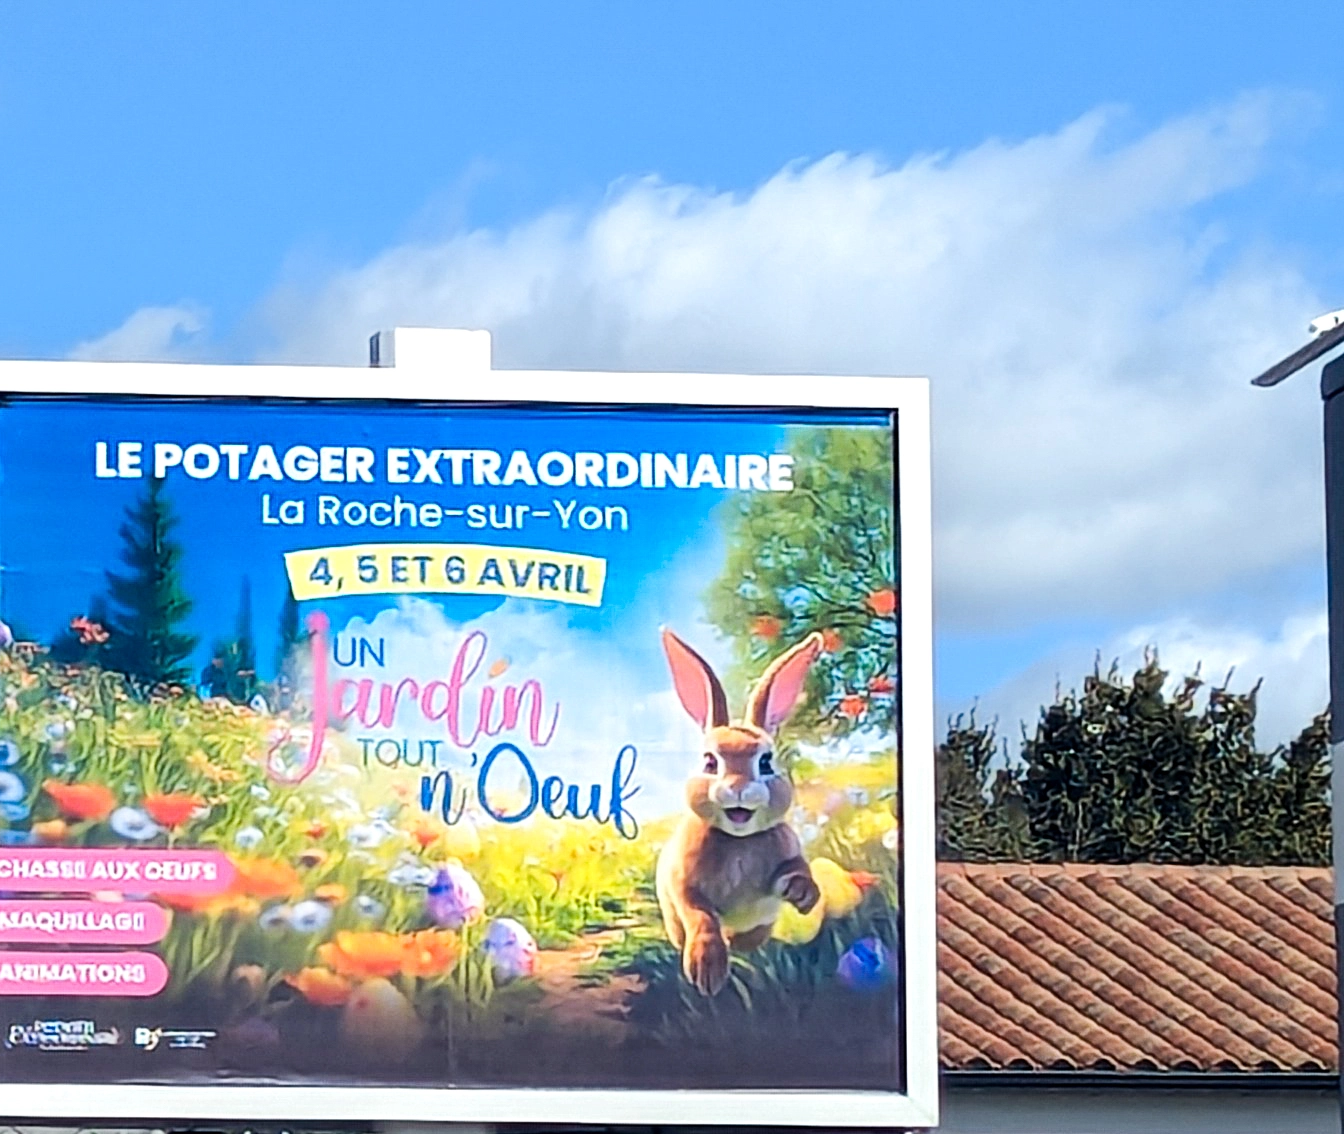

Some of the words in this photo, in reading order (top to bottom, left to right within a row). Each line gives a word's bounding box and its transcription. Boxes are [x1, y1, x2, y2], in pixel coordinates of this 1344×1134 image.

[95, 441, 143, 478] LE
[154, 443, 375, 482] POTAGER
[386, 448, 795, 491] EXTRAORDINAIRE
[261, 493, 305, 524] La
[318, 494, 629, 531] Roche-sur-Yon
[309, 556, 345, 592] 4,
[357, 554, 379, 584] 5
[391, 556, 434, 584] ET
[444, 556, 466, 585] 6
[476, 558, 591, 594] AVRIL
[332, 636, 386, 668] UN
[266, 611, 560, 785] Jardin
[357, 738, 444, 767] TOUT
[91, 860, 141, 880] AUX
